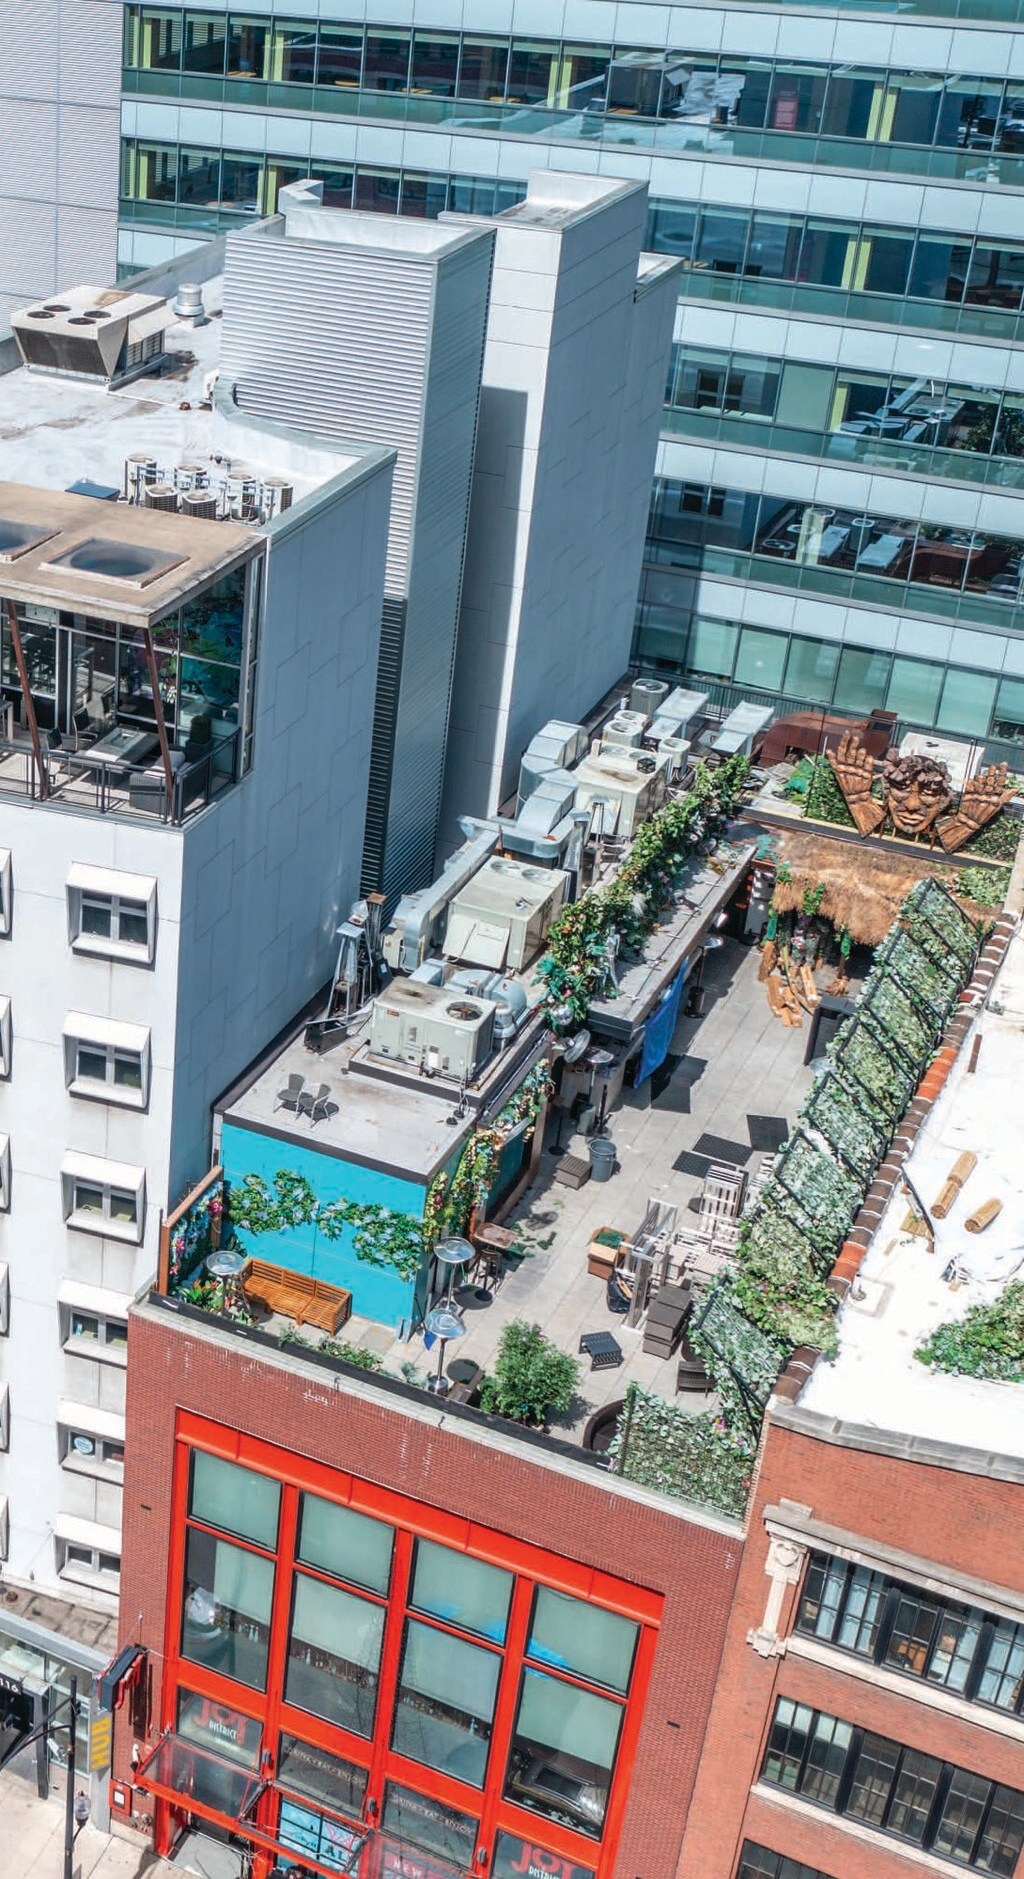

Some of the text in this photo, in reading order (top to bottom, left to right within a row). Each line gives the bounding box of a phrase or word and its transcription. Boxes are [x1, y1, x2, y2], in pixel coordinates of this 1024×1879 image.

[209, 1720, 238, 1740] DISTRICT
[90, 1717, 110, 1770] HUB
[392, 1859, 422, 1878] NEW
